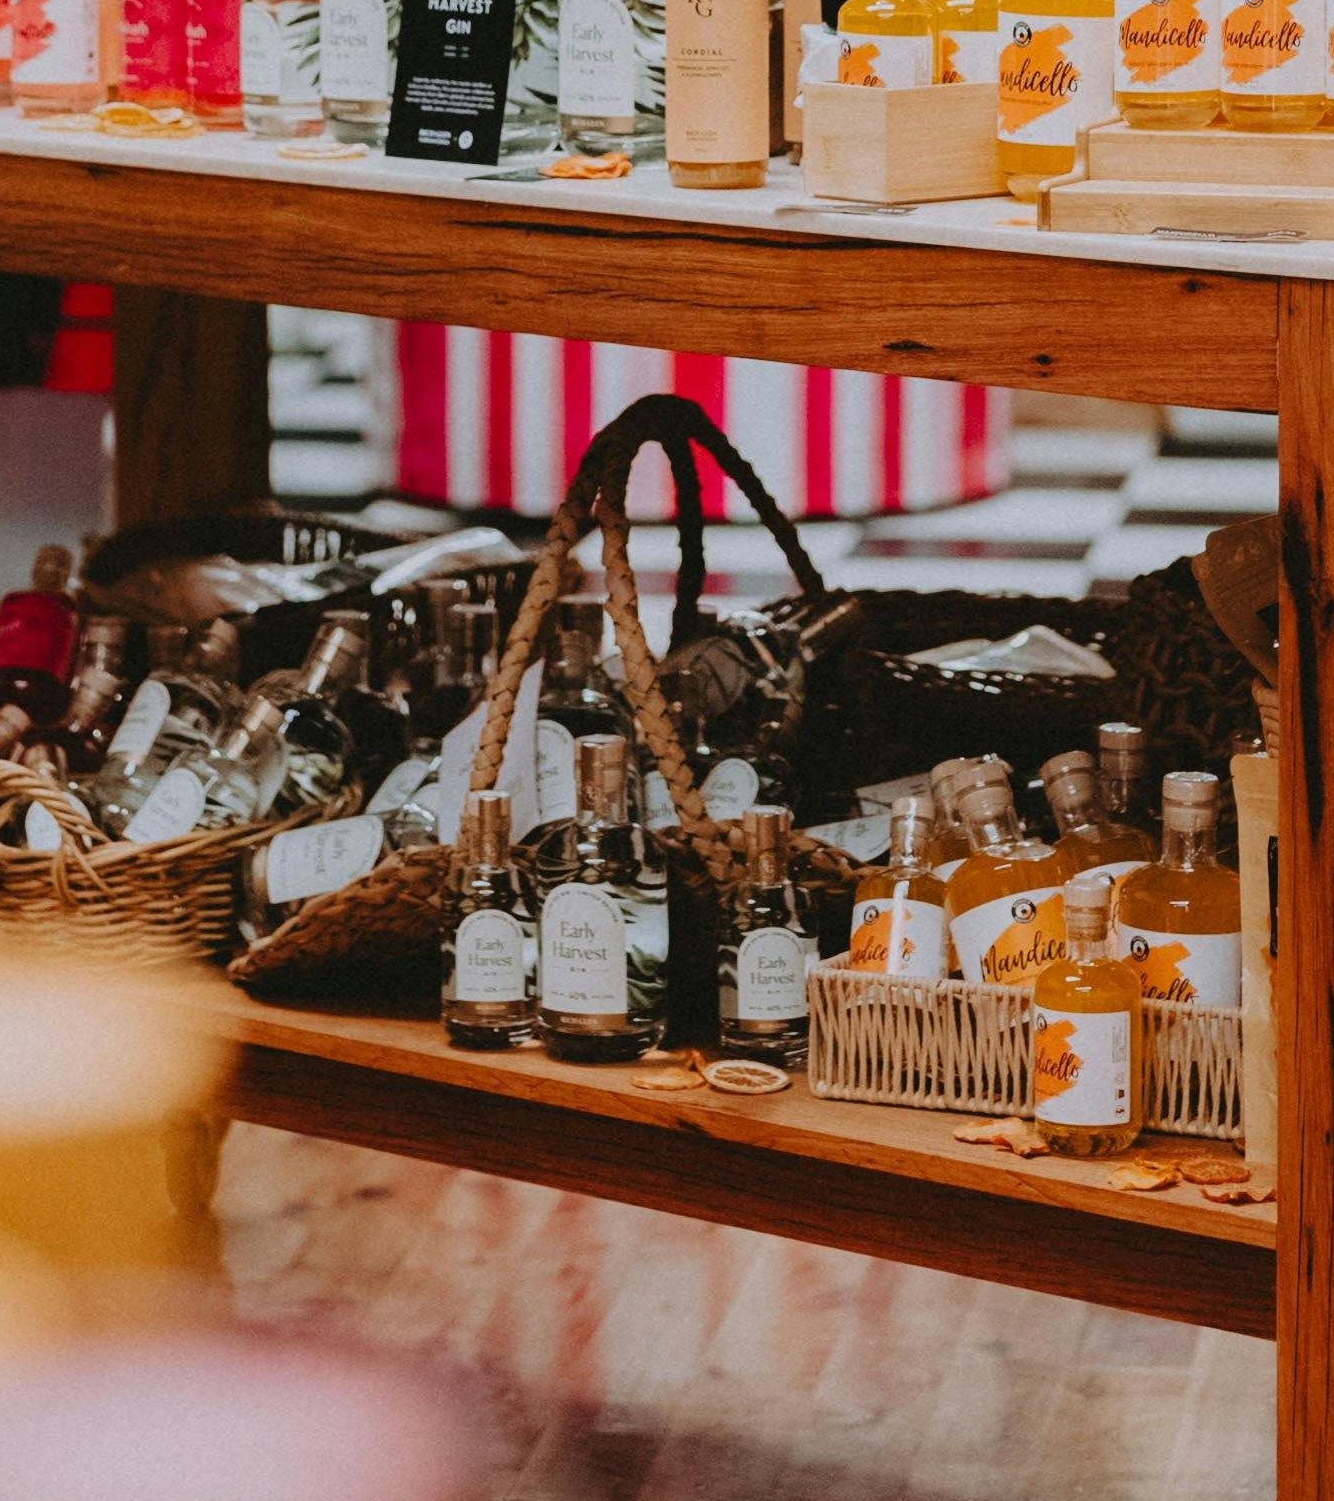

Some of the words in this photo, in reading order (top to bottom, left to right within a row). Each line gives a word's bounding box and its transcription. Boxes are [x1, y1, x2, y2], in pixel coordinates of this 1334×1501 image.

[445, 18, 472, 35] GIN
[560, 920, 596, 943] Early
[552, 940, 608, 961] Harvest
[979, 930, 1071, 983] Mandice
